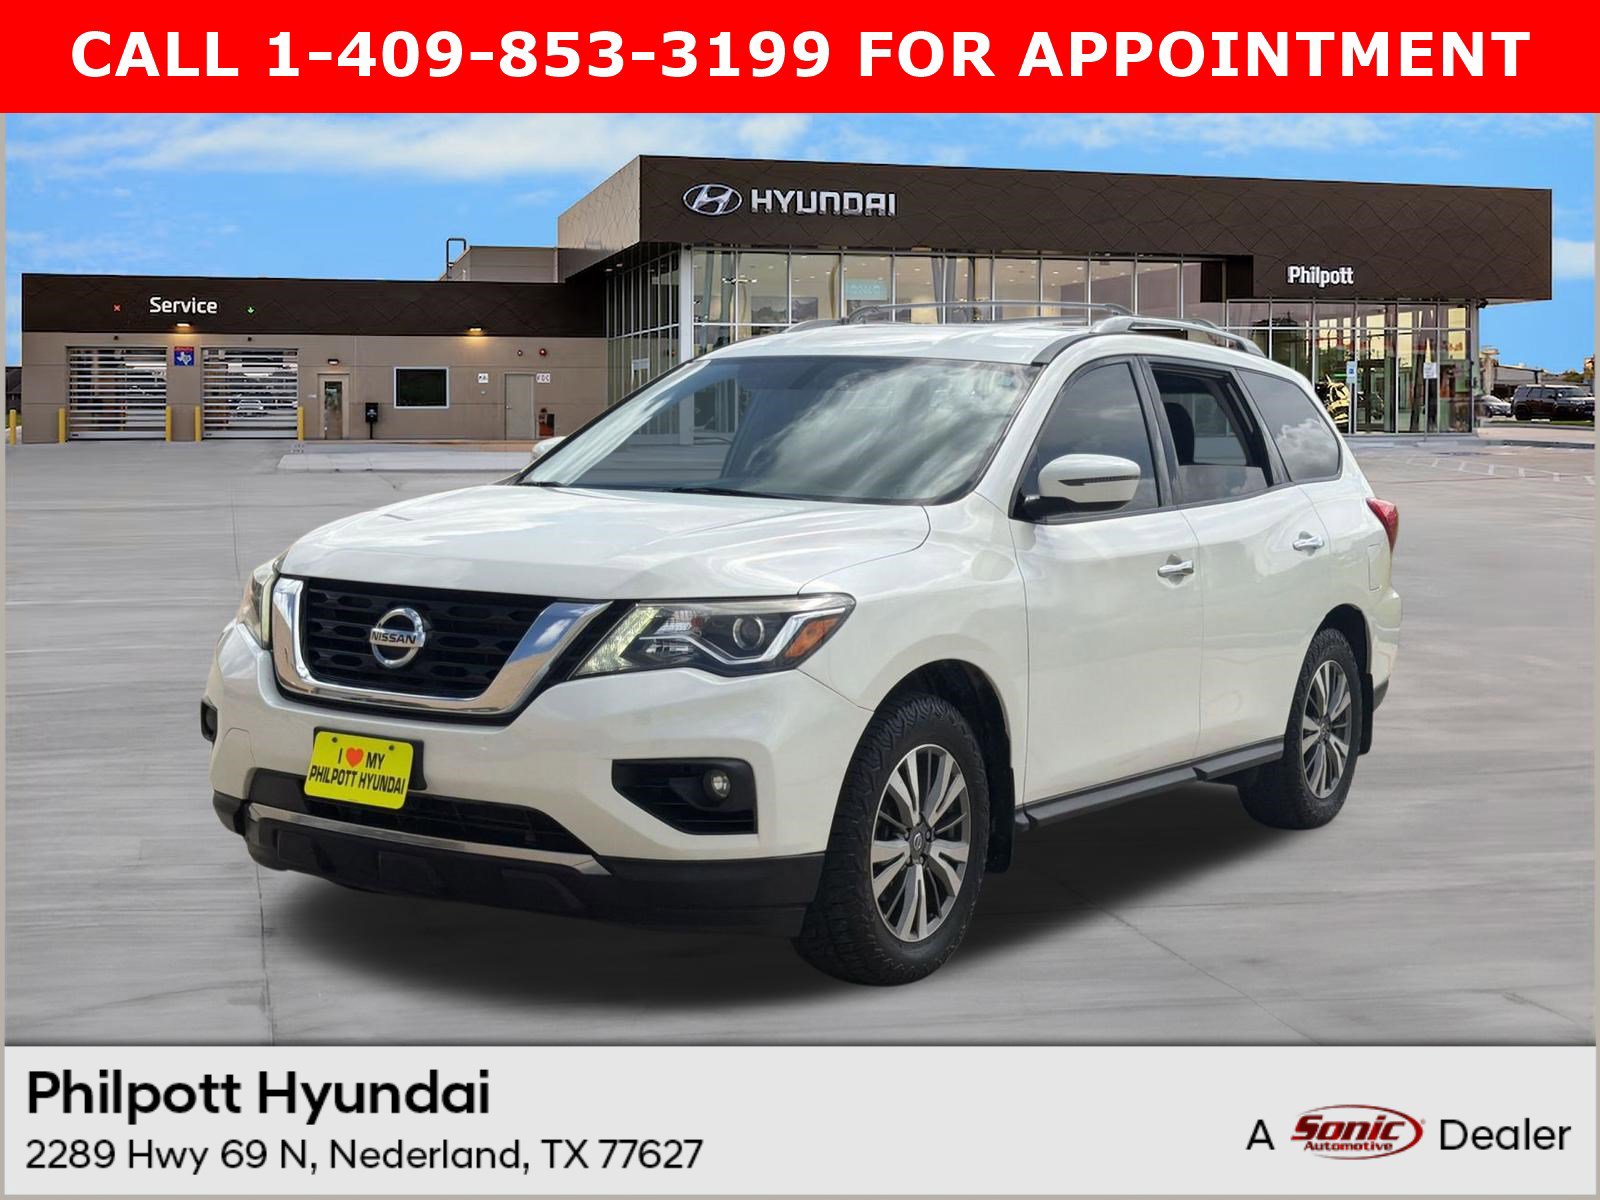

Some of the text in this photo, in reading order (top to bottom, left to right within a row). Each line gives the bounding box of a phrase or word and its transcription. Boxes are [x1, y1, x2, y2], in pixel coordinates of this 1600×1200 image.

[751, 189, 896, 217] HYUNDAI
[1287, 265, 1354, 288] Philpott
[149, 296, 218, 315] Service
[371, 631, 417, 644] NISSAN
[365, 751, 386, 769] MY
[308, 765, 406, 794] PHILPOTT HYUNDAI
